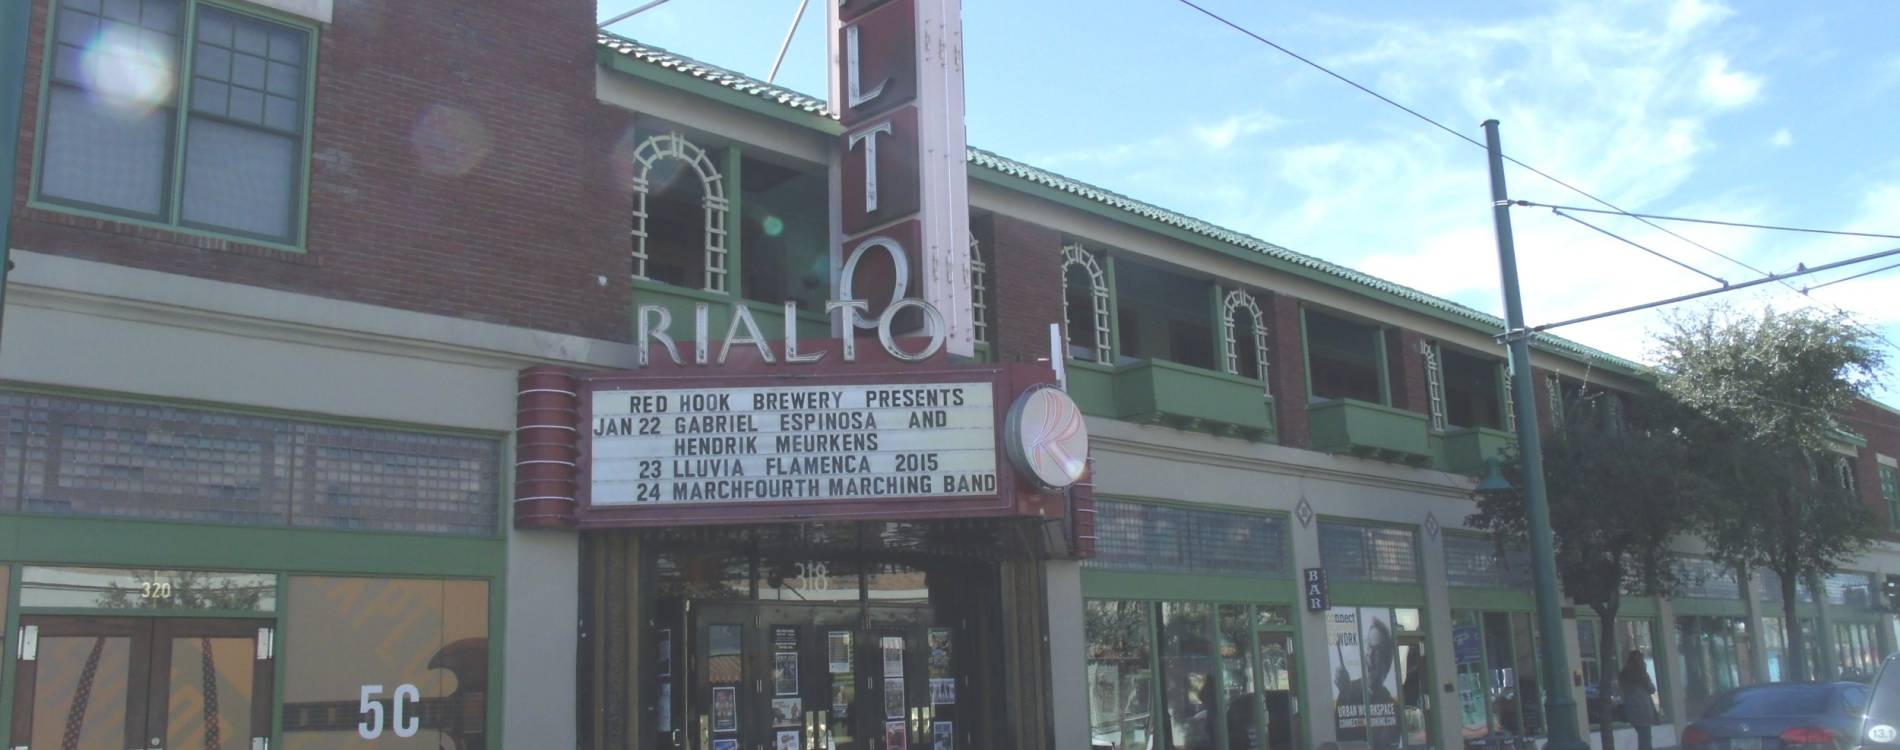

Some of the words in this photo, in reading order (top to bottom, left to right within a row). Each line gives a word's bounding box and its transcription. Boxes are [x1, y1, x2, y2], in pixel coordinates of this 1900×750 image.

[840, 0, 908, 329] LTO
[638, 299, 946, 366] RIALTO
[630, 395, 668, 413] RED
[679, 393, 730, 412] HOOK
[753, 391, 843, 410] BREWERY
[865, 388, 964, 407] PRESENTS
[593, 418, 632, 436] JAN
[638, 416, 661, 435] 22
[674, 414, 758, 434] GABRIEL
[780, 412, 877, 432] ESPINOSA
[908, 410, 947, 429] AND
[674, 435, 757, 455] HENDRIK
[775, 433, 878, 453] MEURKENS
[639, 460, 662, 479] 23
[673, 458, 744, 478] LLUVIA
[766, 454, 871, 476] FLAMENCA
[895, 453, 938, 472] 2015
[637, 482, 661, 501] 24
[672, 478, 820, 500] MARCHFOURTH
[829, 475, 932, 497] MARCHING
[943, 473, 996, 493] BAND
[142, 582, 170, 598] 320
[794, 562, 828, 592] 318
[1308, 569, 1322, 609] BAR
[358, 684, 420, 740] 5C
[1873, 728, 1893, 739] 13.1
